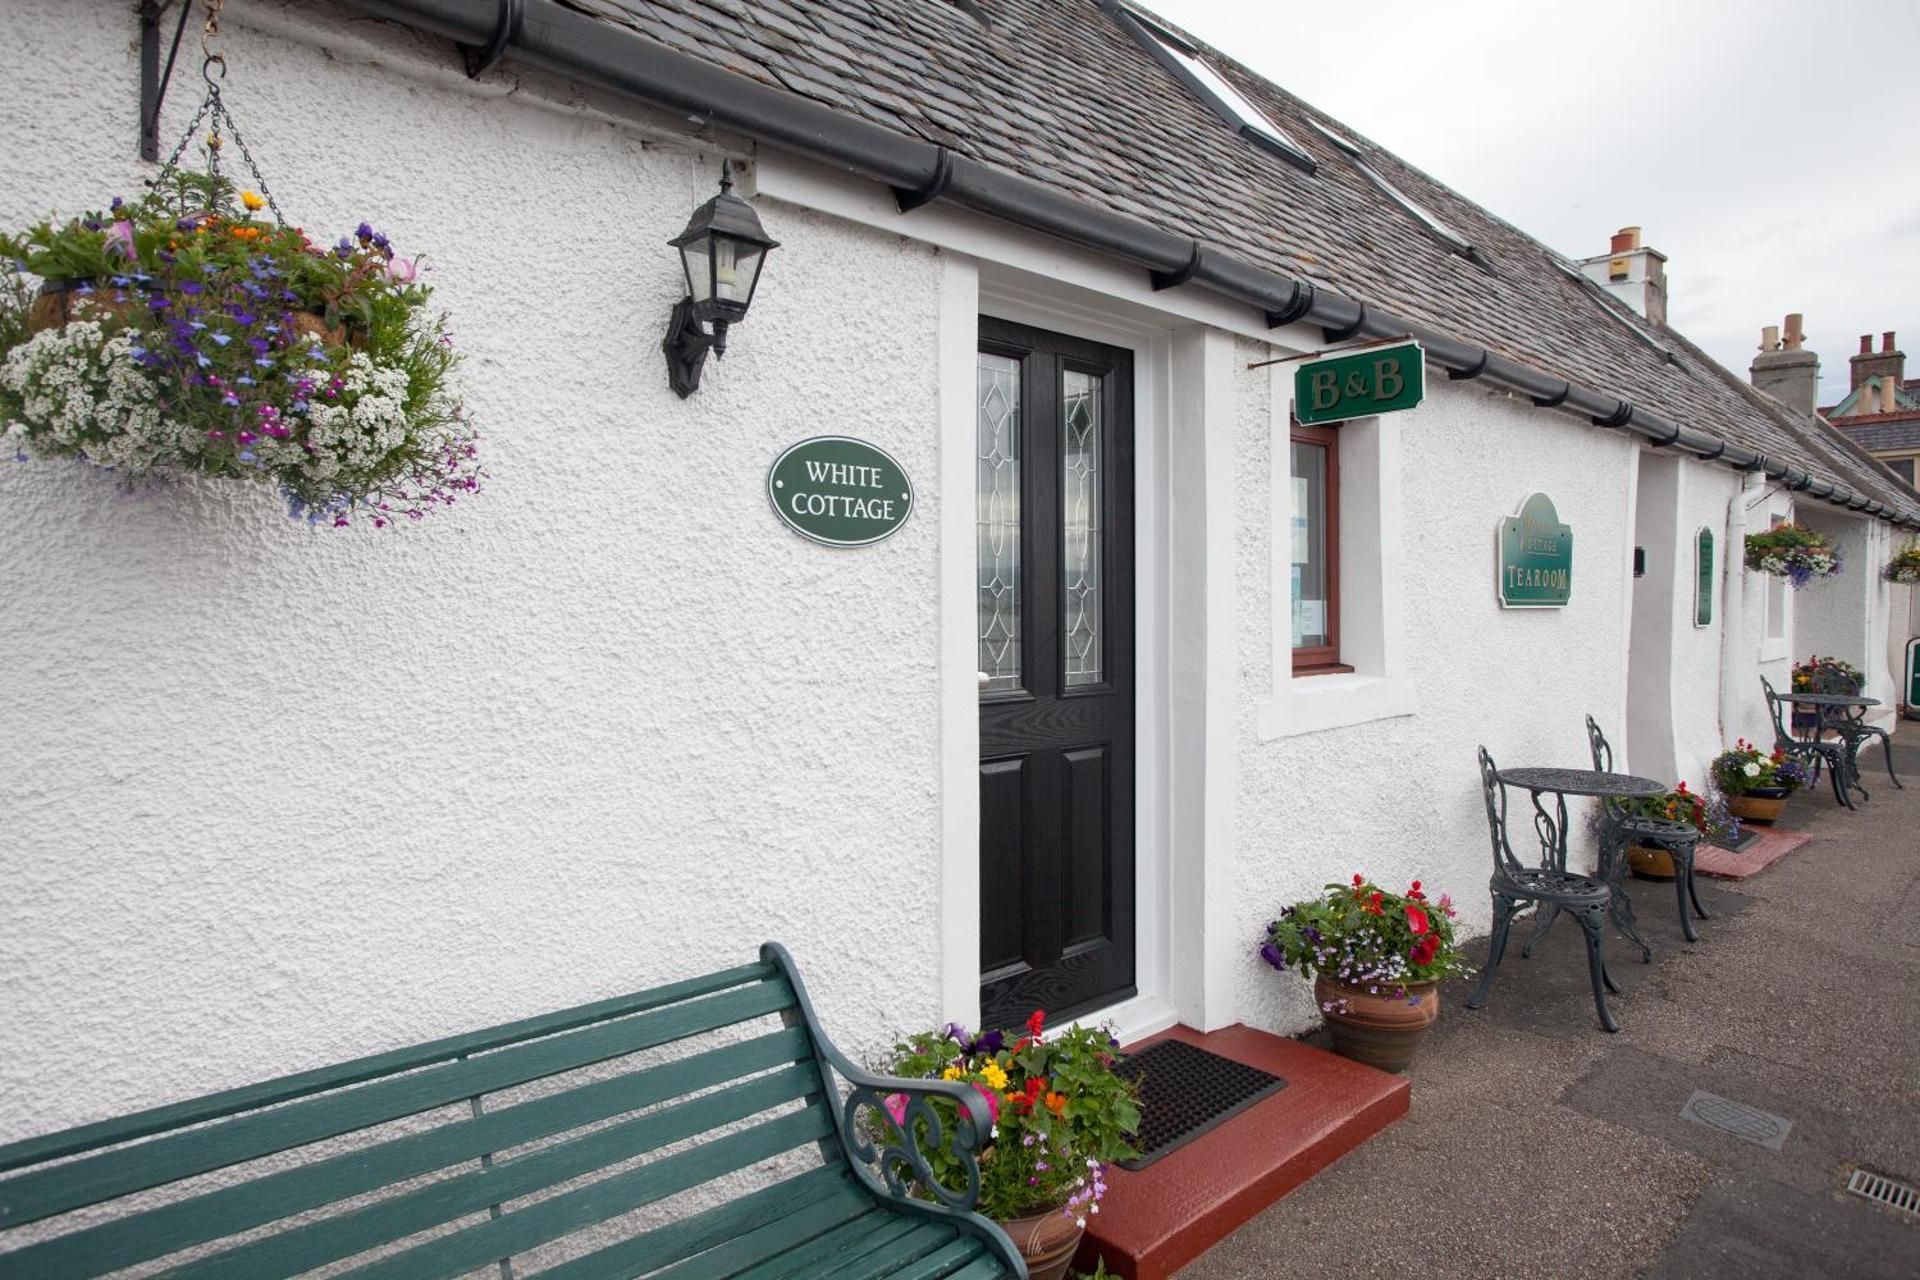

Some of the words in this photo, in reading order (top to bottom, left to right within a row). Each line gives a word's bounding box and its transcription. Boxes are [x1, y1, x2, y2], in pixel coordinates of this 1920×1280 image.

[1311, 358, 1404, 411] B&B
[805, 461, 883, 488] WHITE
[791, 493, 895, 520] COTTAGE
[1507, 565, 1566, 590] TEAROOM
